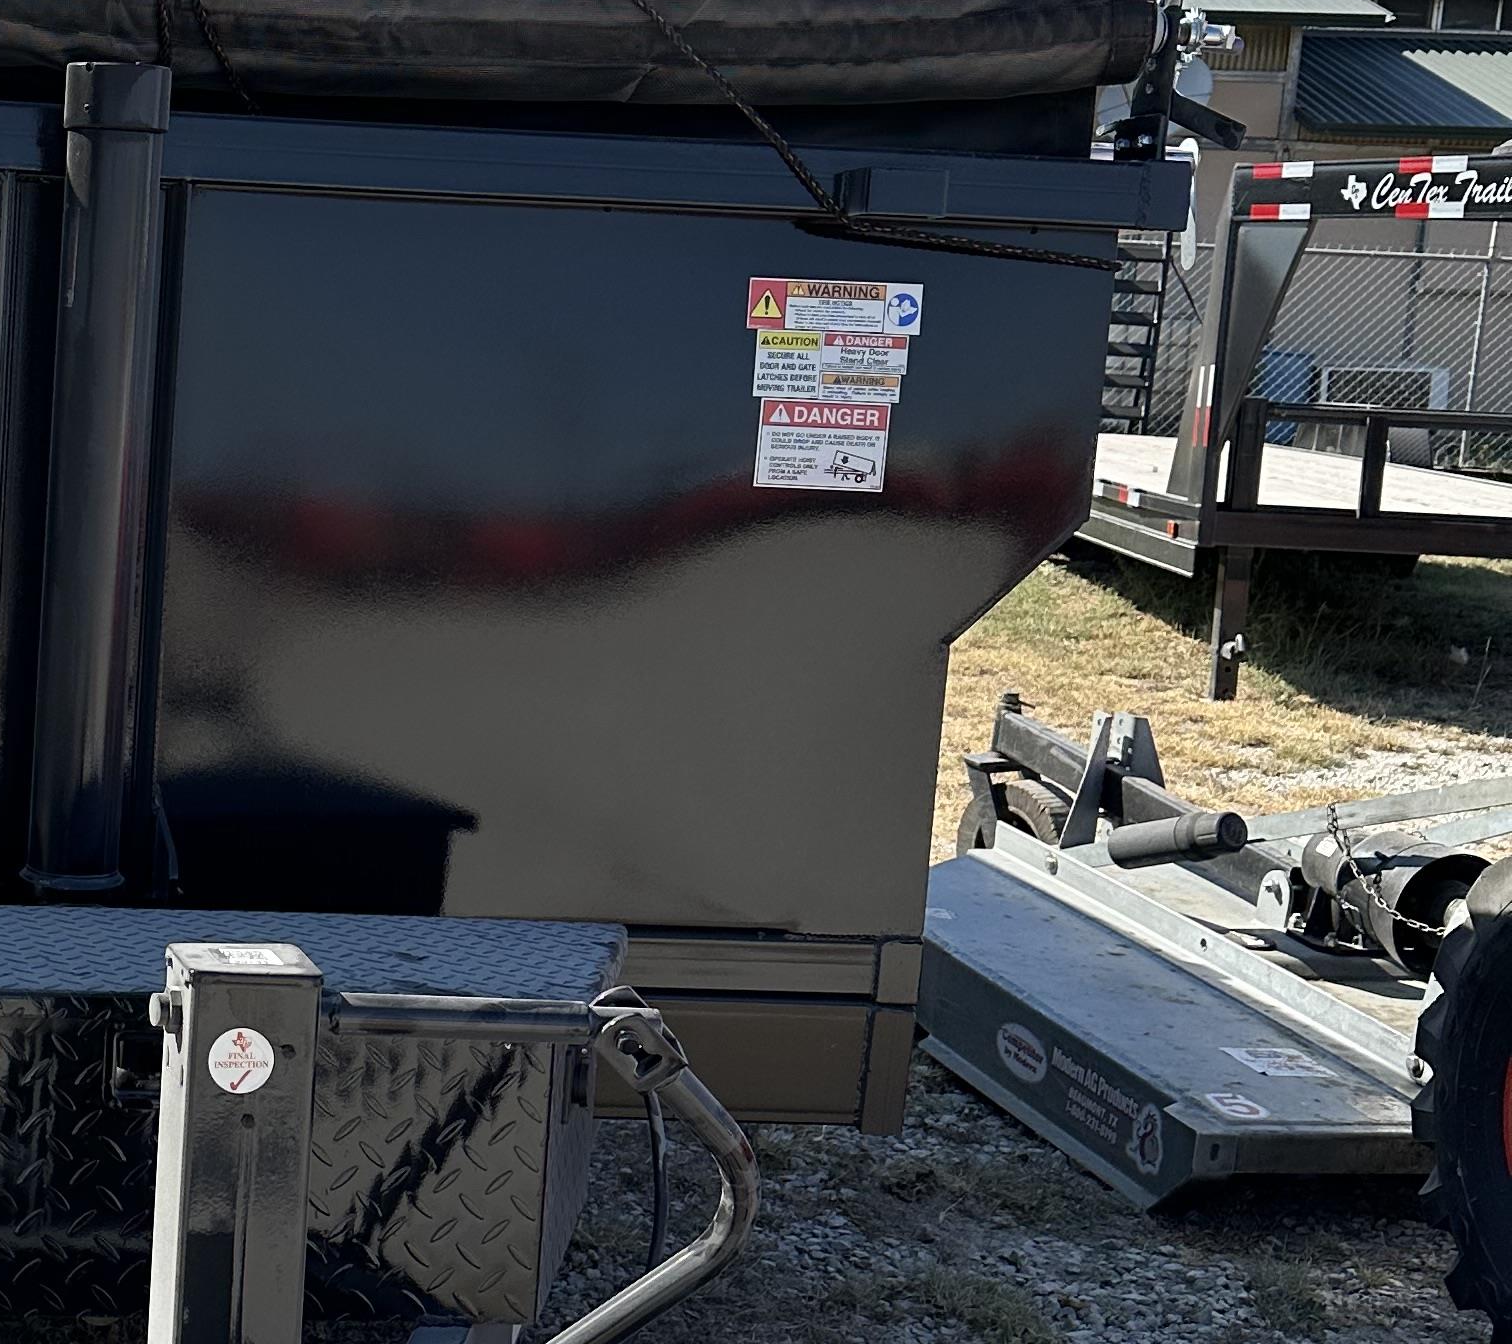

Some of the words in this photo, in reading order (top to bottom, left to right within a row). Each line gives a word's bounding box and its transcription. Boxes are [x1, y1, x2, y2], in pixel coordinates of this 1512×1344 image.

[1371, 172, 1449, 210] CenTex
[807, 284, 880, 298] WARNING
[771, 336, 818, 347] CAUTION
[845, 336, 893, 347] DANGER
[840, 347, 867, 358] Heavy
[868, 349, 890, 357] Door
[798, 363, 816, 371] GATE
[757, 372, 789, 381] LATCHES
[841, 375, 886, 386] WARNING
[787, 384, 817, 393] TRAILER
[793, 406, 879, 427] DANGER
[214, 1060, 269, 1069] INSPECTION
[1051, 1046, 1086, 1085] Modern
[1097, 1076, 1139, 1119] Products
